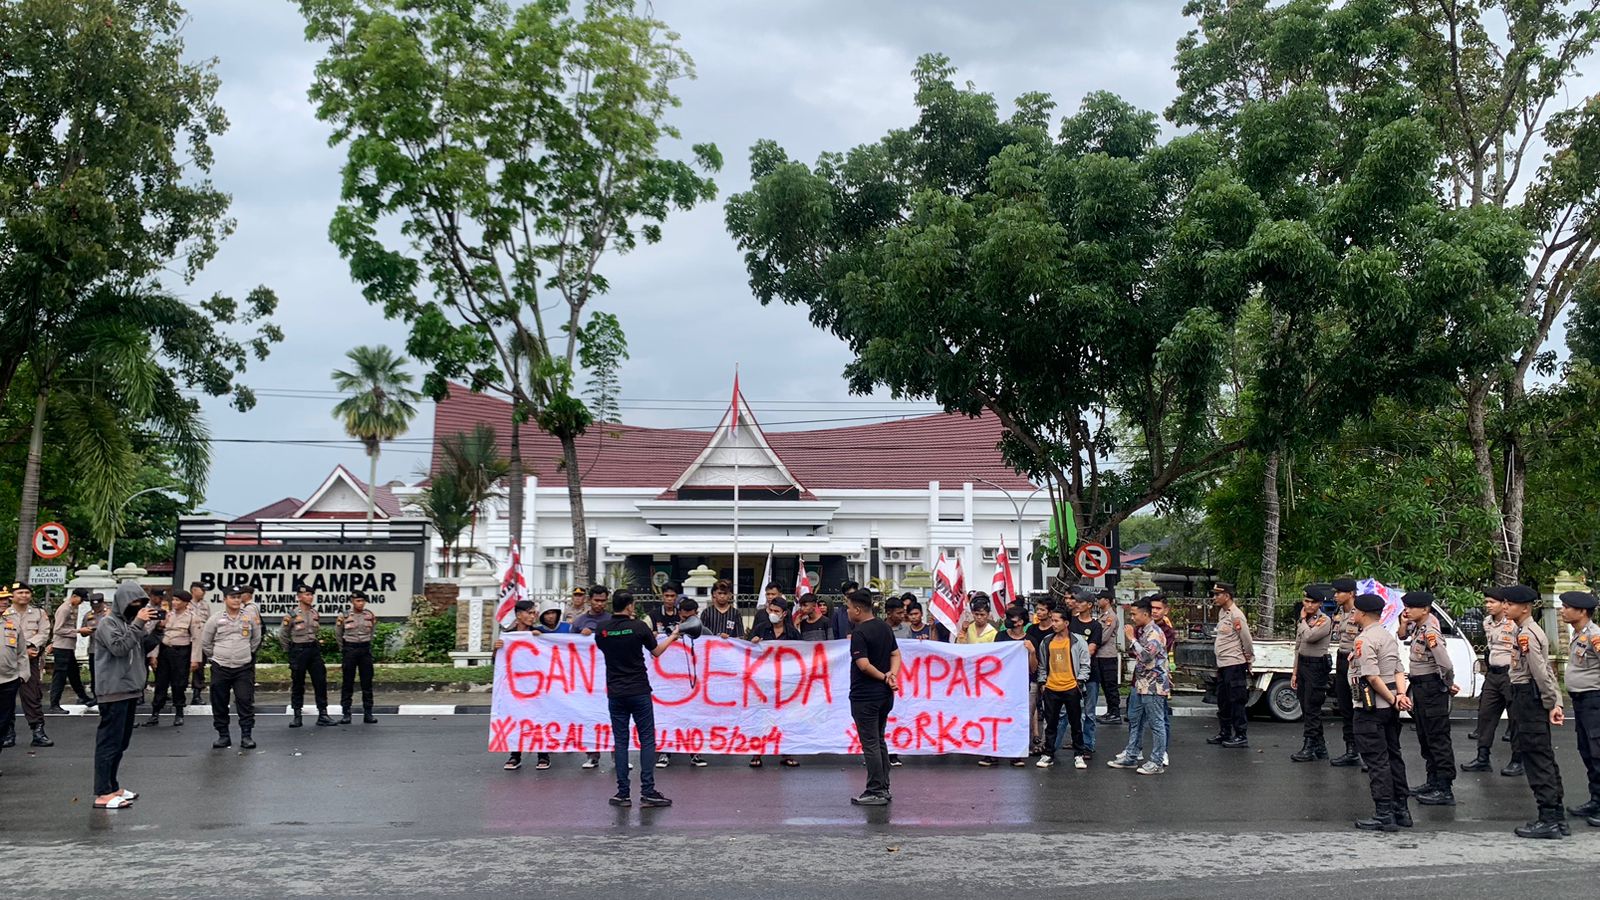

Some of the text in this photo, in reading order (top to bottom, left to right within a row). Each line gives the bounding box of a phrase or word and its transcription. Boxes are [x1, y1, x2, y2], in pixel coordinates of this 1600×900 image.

[223, 555, 376, 570] RUMAH DINAS
[200, 573, 397, 592] BUPATI KAMPAR
[317, 594, 386, 604] BANGKANG
[505, 638, 1005, 710] GAN SEKDA MPAR
[518, 718, 589, 753] PASAL
